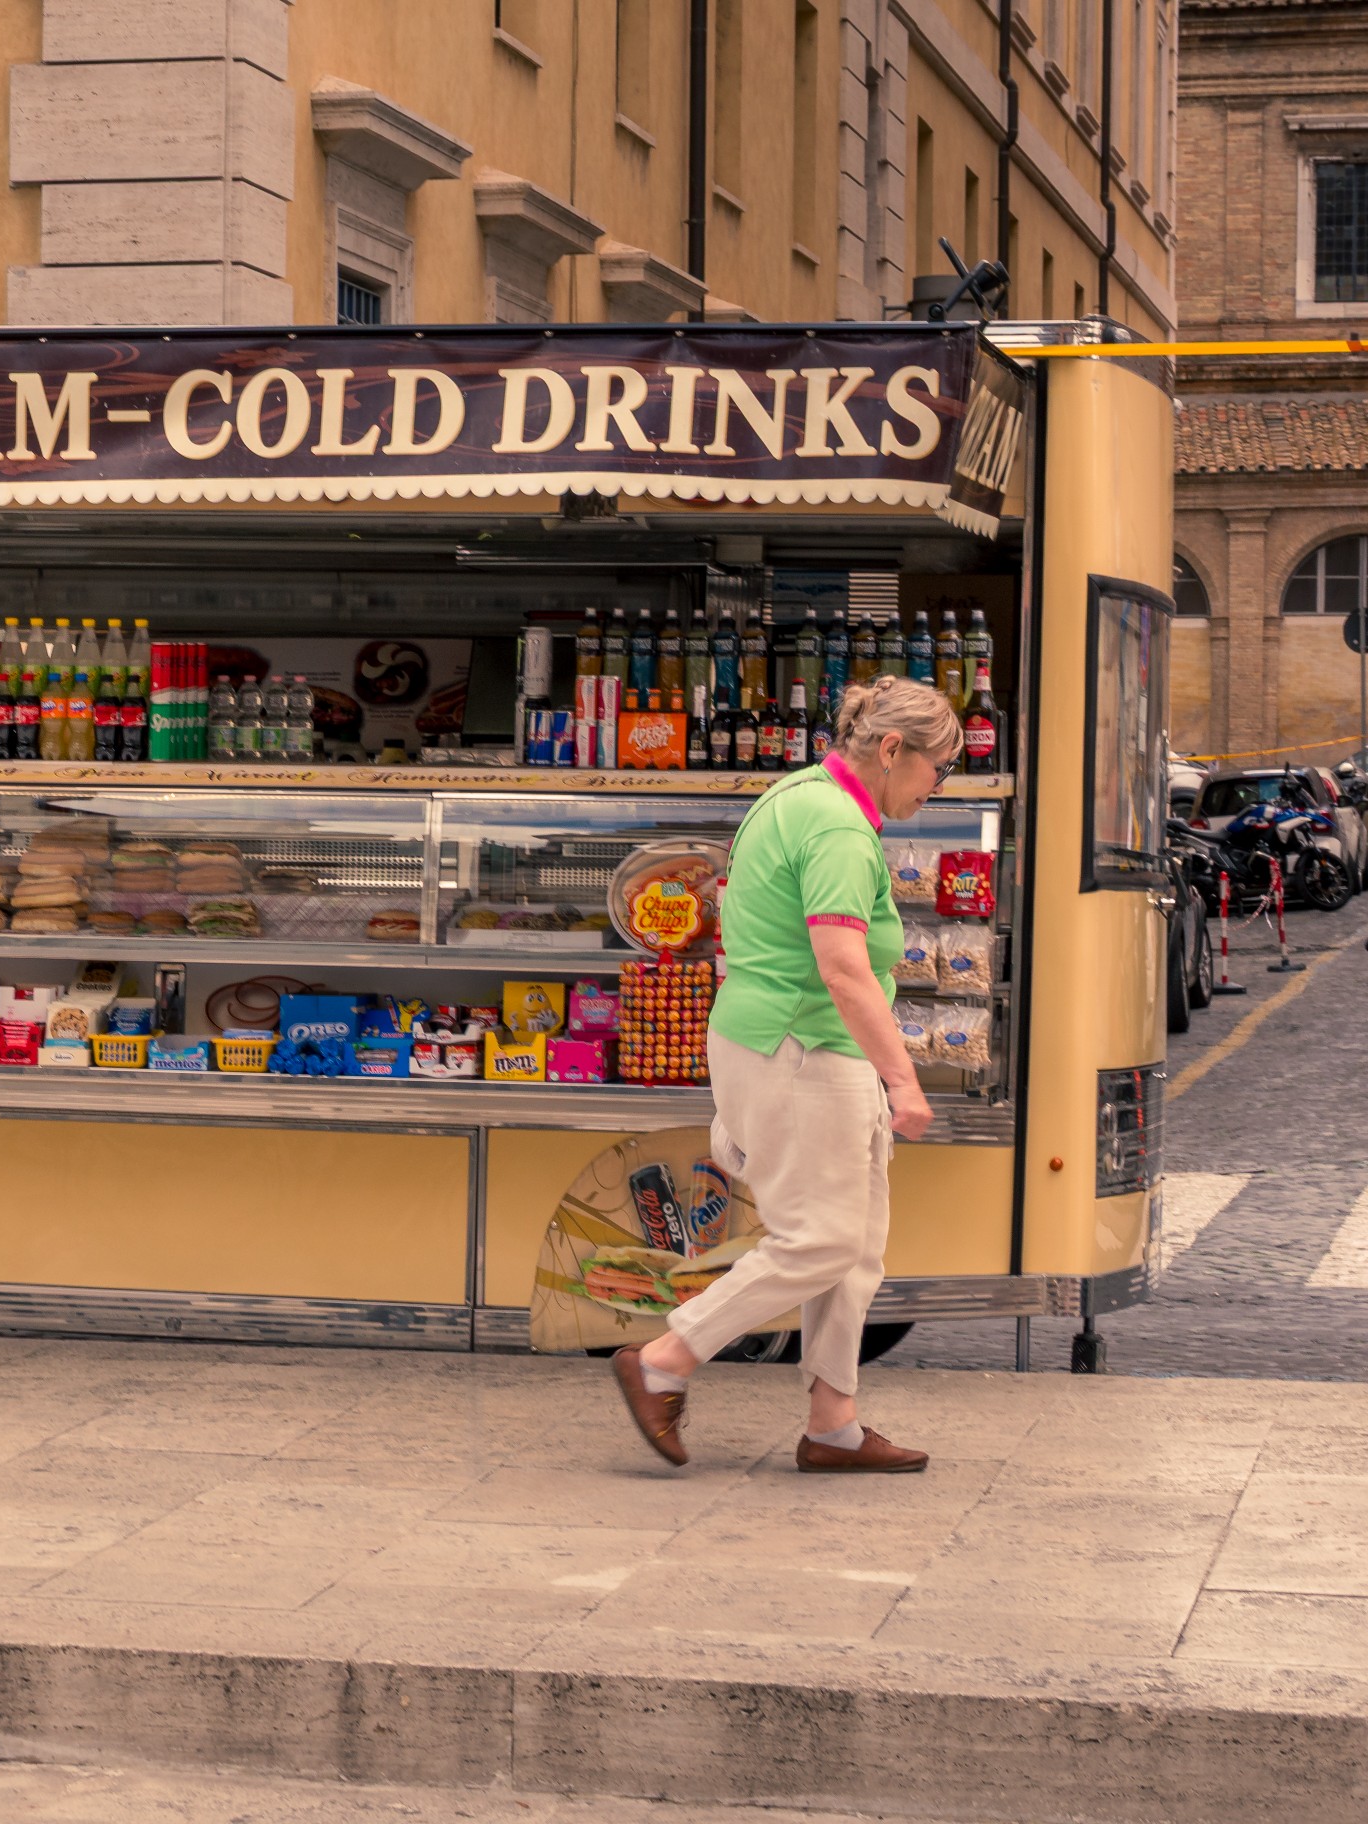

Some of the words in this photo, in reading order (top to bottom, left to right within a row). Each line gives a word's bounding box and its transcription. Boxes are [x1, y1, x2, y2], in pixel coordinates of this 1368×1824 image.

[492, 364, 941, 461] DRINKS
[952, 876, 979, 892] RITZ
[642, 895, 691, 912] Chupa
[640, 912, 688, 930] Chups
[288, 1022, 351, 1043] OREO
[154, 1058, 203, 1070] mentos
[662, 1202, 683, 1243] zero
